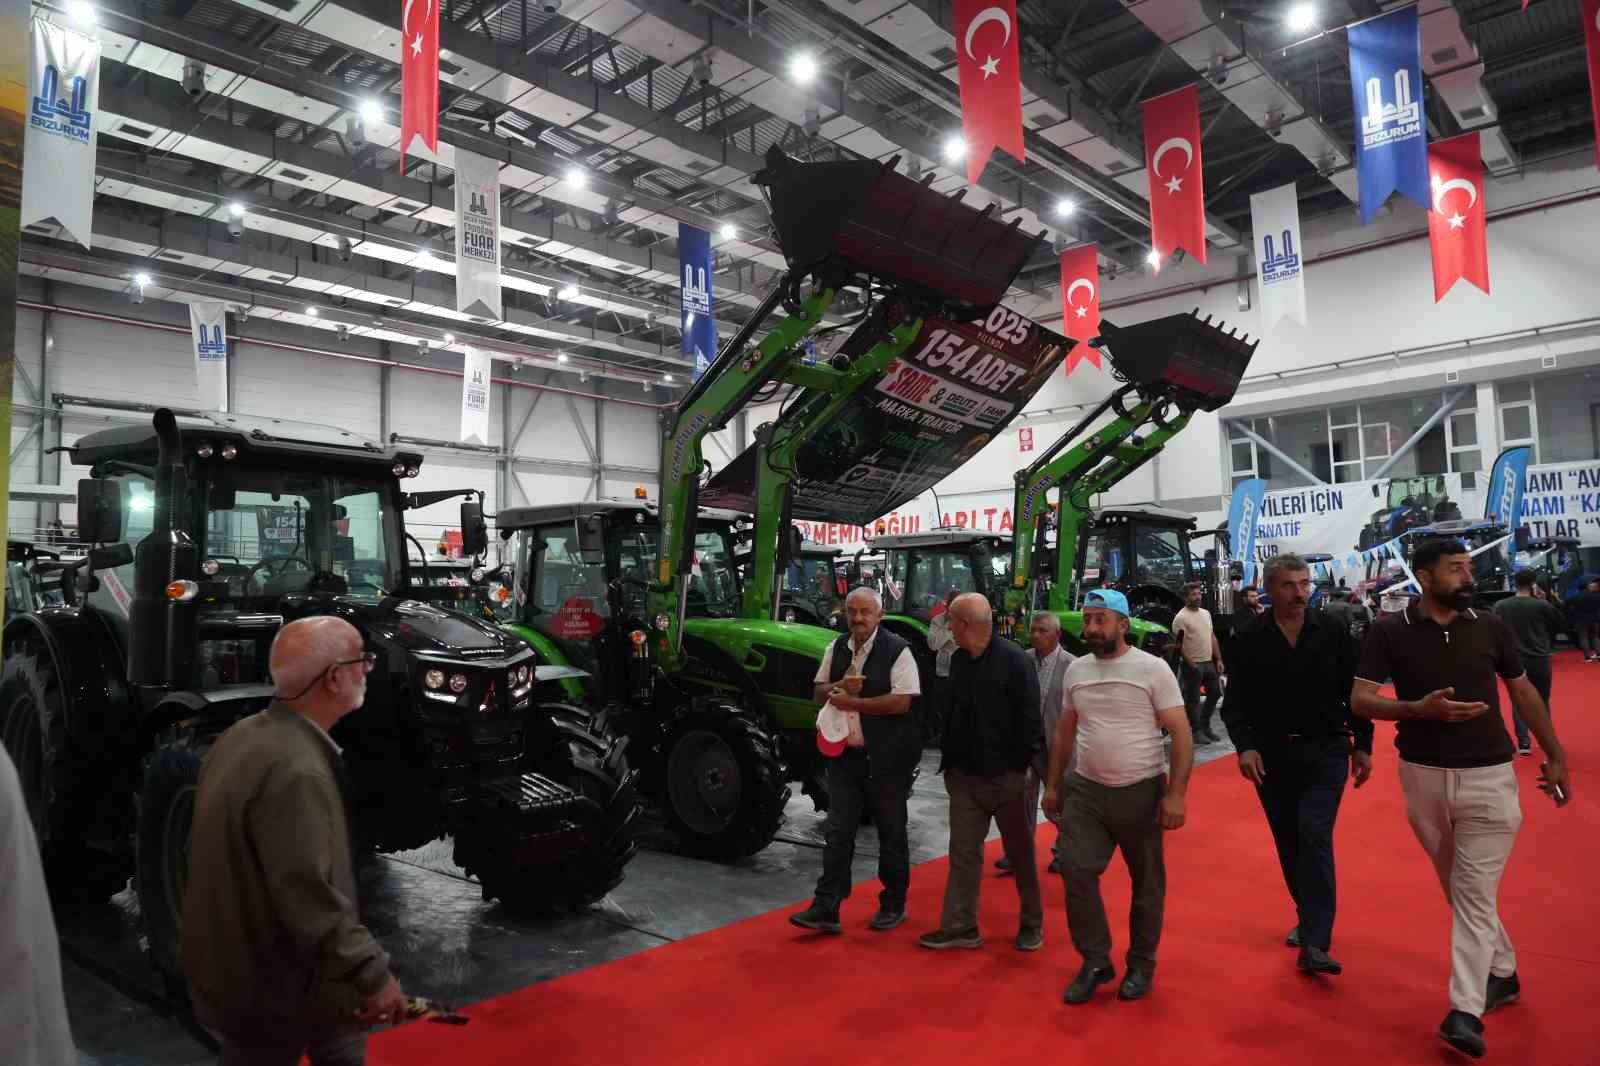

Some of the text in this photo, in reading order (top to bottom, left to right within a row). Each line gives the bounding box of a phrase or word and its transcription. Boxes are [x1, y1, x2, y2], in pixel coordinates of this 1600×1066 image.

[31, 115, 89, 140] ERZURUM
[1363, 121, 1420, 146] ERZURUM
[464, 231, 493, 249] FUAR
[971, 305, 1033, 345] 025
[914, 328, 1027, 394] 154 ADET
[876, 398, 920, 424] MARKA
[929, 387, 947, 405] &
[946, 392, 978, 410] DEUTZ
[1524, 471, 1563, 493] AMI
[1311, 489, 1343, 515] İÇİN
[1256, 519, 1301, 539] RNATİF
